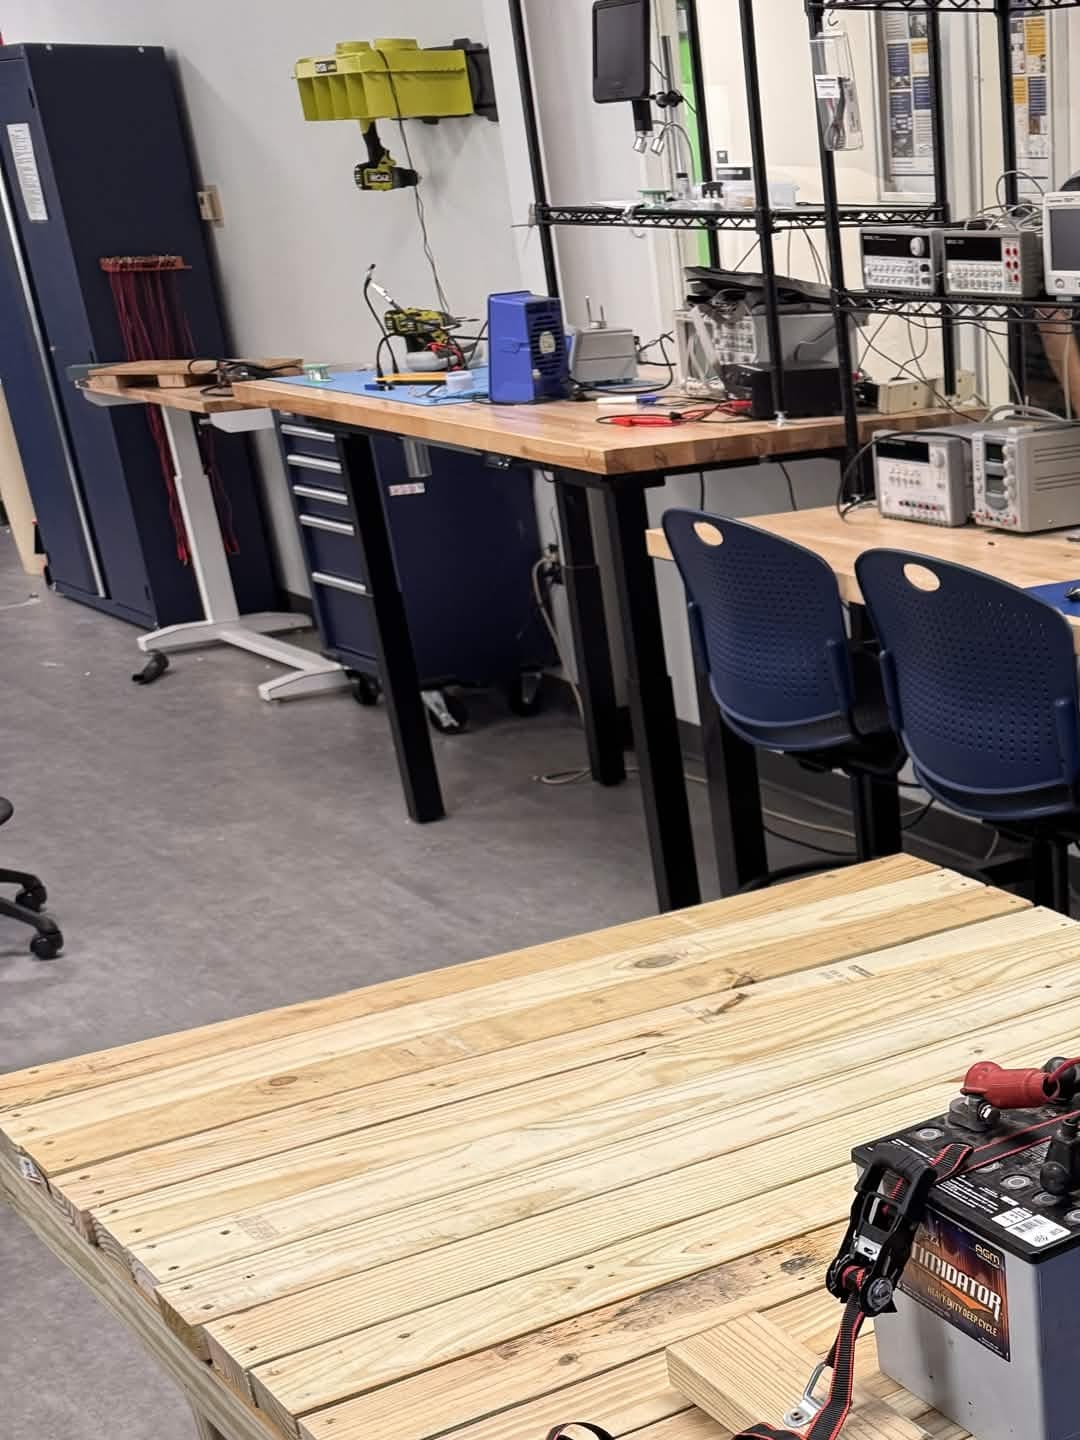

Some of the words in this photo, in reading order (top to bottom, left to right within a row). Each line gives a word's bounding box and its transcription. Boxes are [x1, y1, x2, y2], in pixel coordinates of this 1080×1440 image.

[975, 1243, 1001, 1265] AGM
[911, 1241, 1002, 1322] TIMIDATOR
[962, 1308, 978, 1323] DEEP
[978, 1318, 998, 1337] CYCLE
